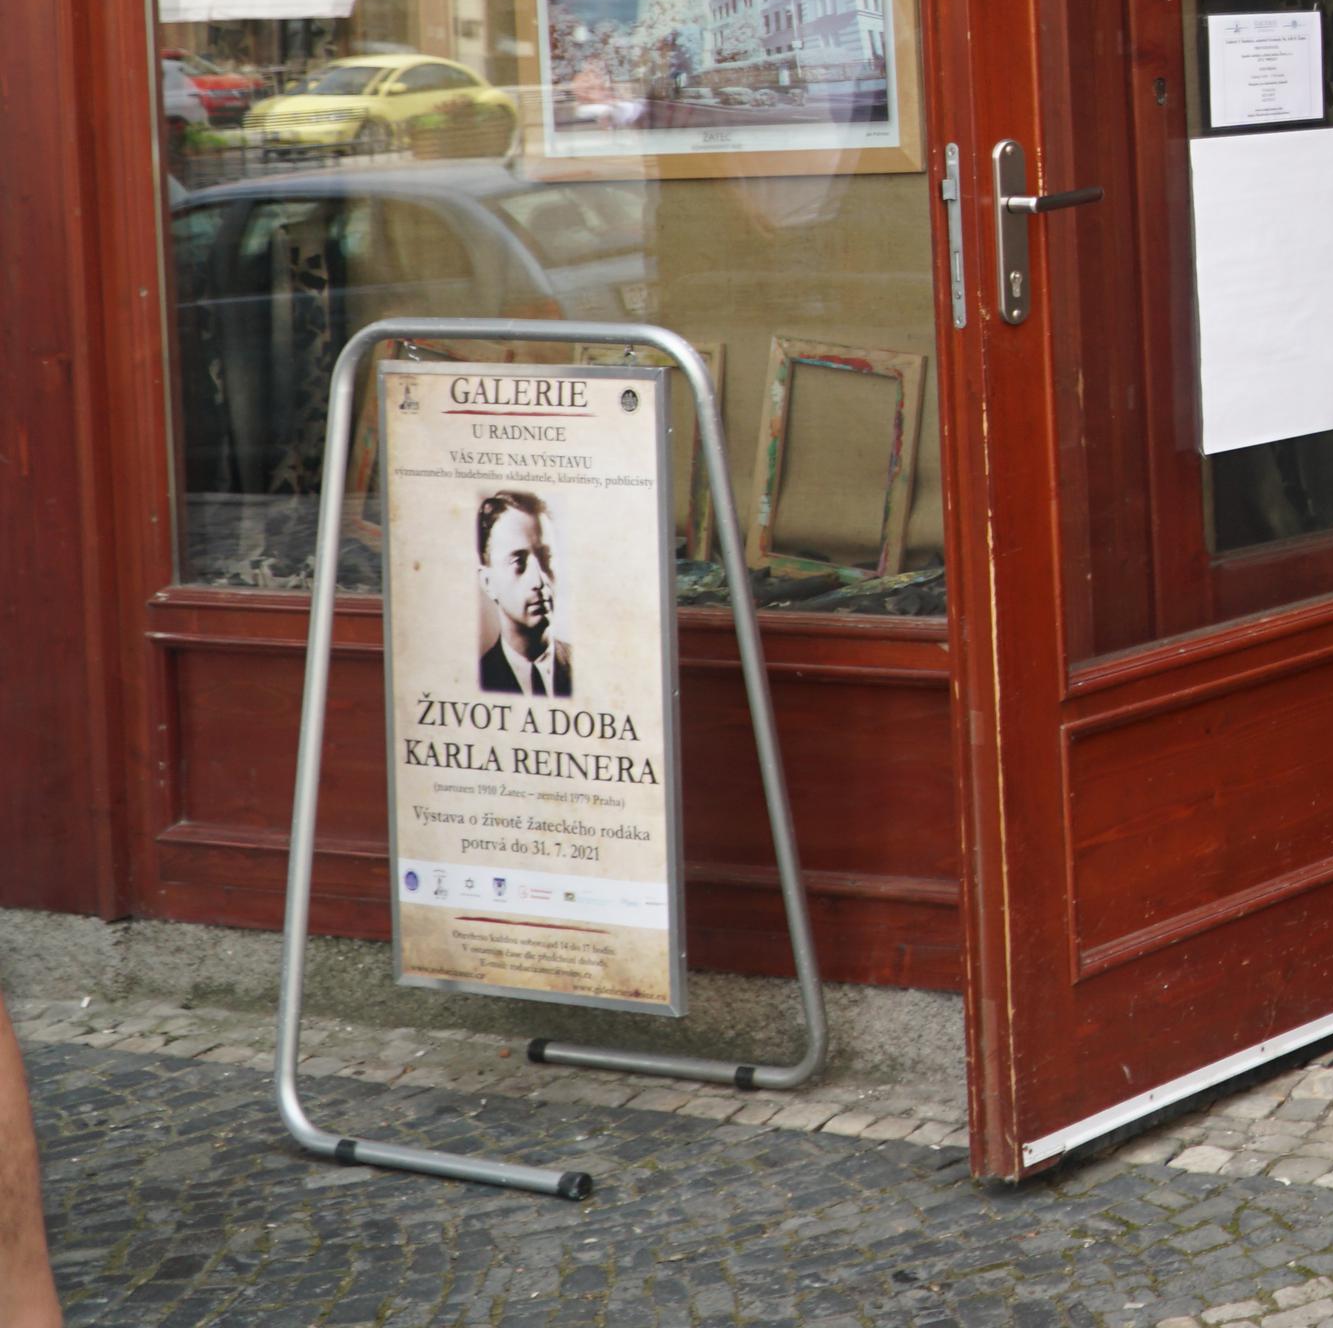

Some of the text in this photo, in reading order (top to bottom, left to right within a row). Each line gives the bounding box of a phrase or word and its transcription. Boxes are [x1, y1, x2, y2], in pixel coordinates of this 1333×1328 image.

[449, 376, 589, 409] GALERIE
[472, 424, 567, 443] U RADNICE
[449, 449, 593, 471] VÁS ZVE NA VÝSTAVU
[604, 475, 655, 491] publicisty
[417, 692, 641, 742] ŽIVOT A DOBA
[403, 738, 660, 786] KARLA REINERA
[412, 804, 651, 842] Výstava o životě žateckého rodáka
[461, 836, 601, 862] potrvá do 31. 7. 2021
